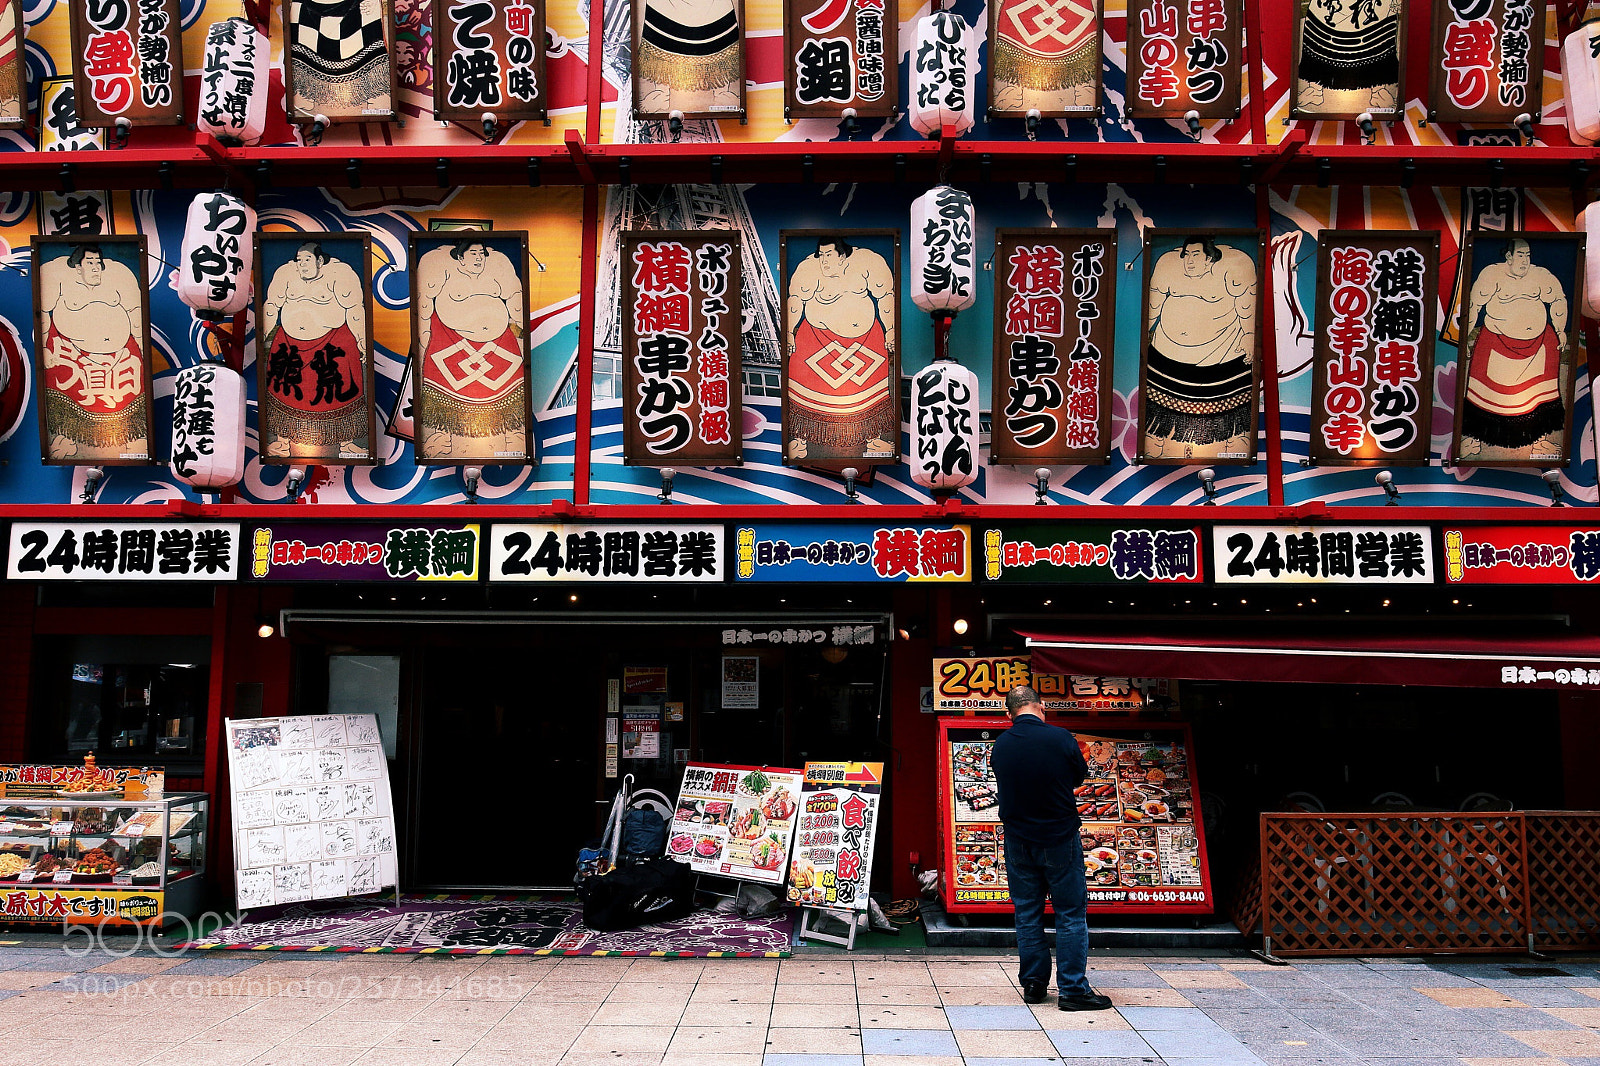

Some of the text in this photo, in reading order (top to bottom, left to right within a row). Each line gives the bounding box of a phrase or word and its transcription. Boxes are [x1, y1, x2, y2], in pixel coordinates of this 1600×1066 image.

[505, 0, 538, 102] 町の味
[1186, 0, 1228, 103] 串かつ
[1498, 0, 1534, 106] が勢揃い
[633, 242, 692, 455] 横綱串かつ
[697, 243, 731, 444] ボリューム横綱級
[1005, 244, 1064, 448] 横綱串かつ
[1067, 243, 1103, 449] ボリューム横綱級
[1321, 246, 1373, 455] 海の幸山の幸
[1368, 247, 1425, 453] 横綱串かつ
[17, 528, 232, 575] 24時間営業
[253, 528, 272, 577] 新世界
[272, 528, 476, 577] 日本一の串かつ 横綱
[501, 531, 717, 577] 24時間営業
[737, 528, 755, 578] 新世界
[756, 528, 966, 577] 日本一の串かつ 横綱
[984, 529, 1002, 579] 新世界
[1002, 529, 1198, 580] 日本一の串かつ 横綱
[1226, 531, 1425, 577] 24時間営業
[1445, 531, 1463, 581] 新世界
[1464, 542, 1568, 568] 日本一の串かつ
[722, 628, 827, 644] 日本一の串かつ
[1137, 889, 1206, 902] 06-6630-8440
